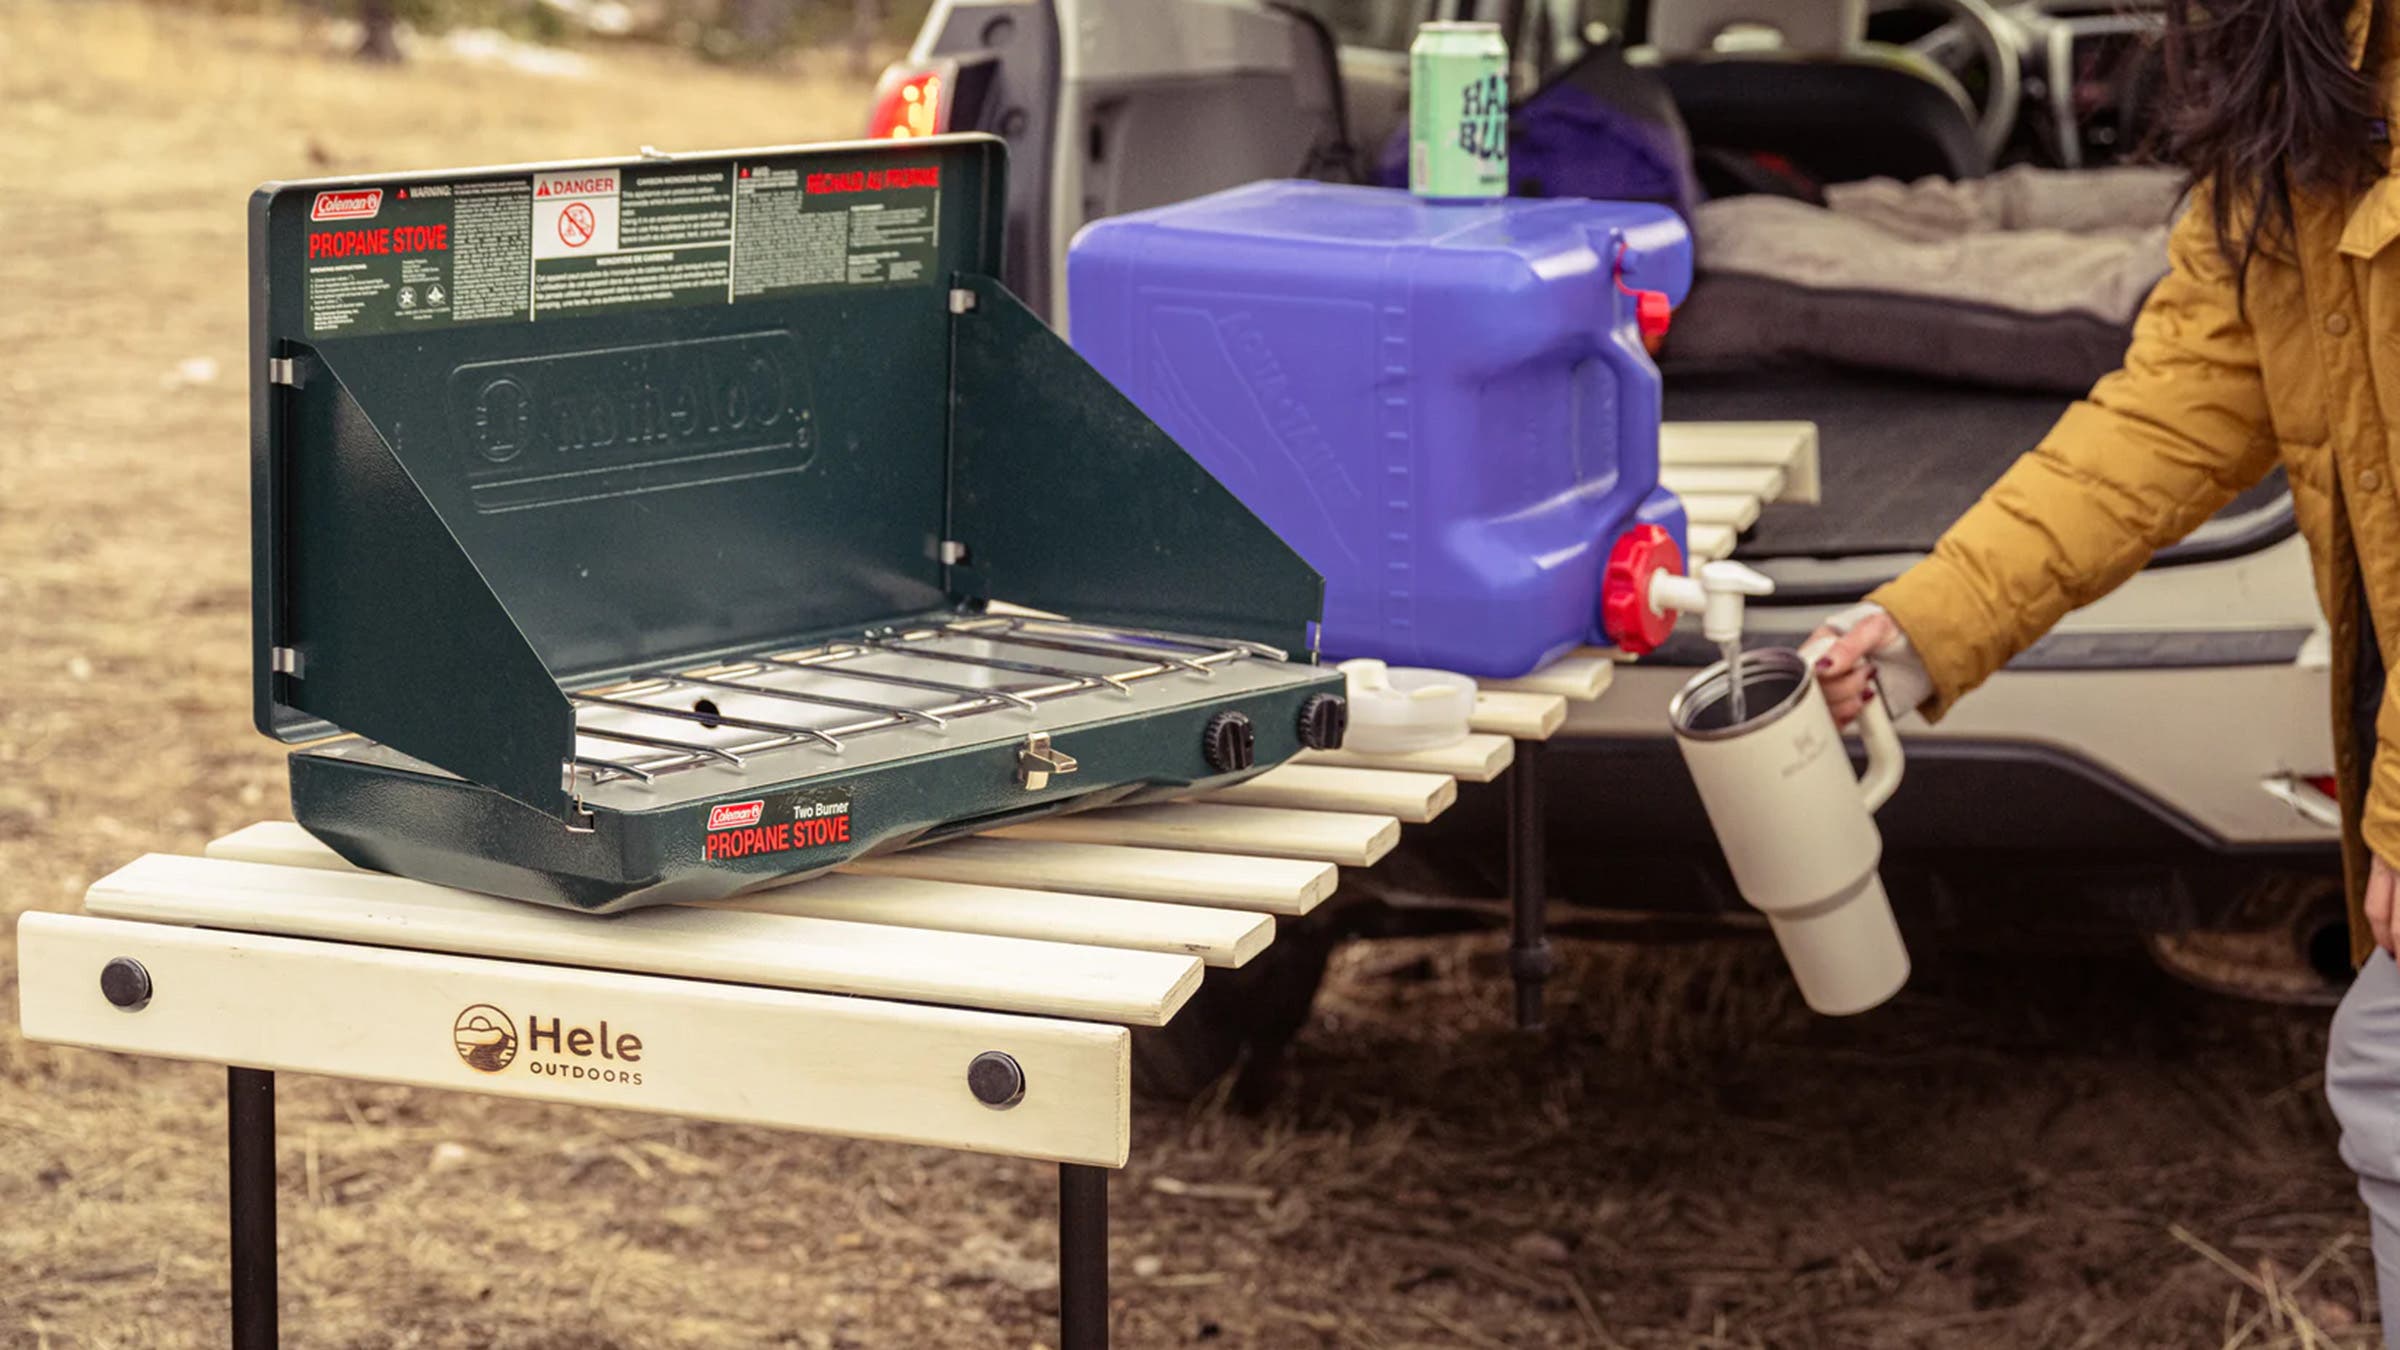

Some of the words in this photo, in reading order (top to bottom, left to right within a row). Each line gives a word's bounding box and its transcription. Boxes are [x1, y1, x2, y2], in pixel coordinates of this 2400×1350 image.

[553, 178, 614, 195] DANGER
[318, 194, 366, 212] Coleman
[309, 229, 390, 260] PROPANE
[393, 224, 447, 253] STOVE
[712, 807, 751, 824] Coleman
[793, 806, 813, 820] Two
[815, 802, 849, 818] Burner
[706, 824, 790, 860] PROPANE
[793, 816, 849, 848] STOVE
[529, 1015, 643, 1062] Hele
[530, 1061, 643, 1085] OUTDOORS
